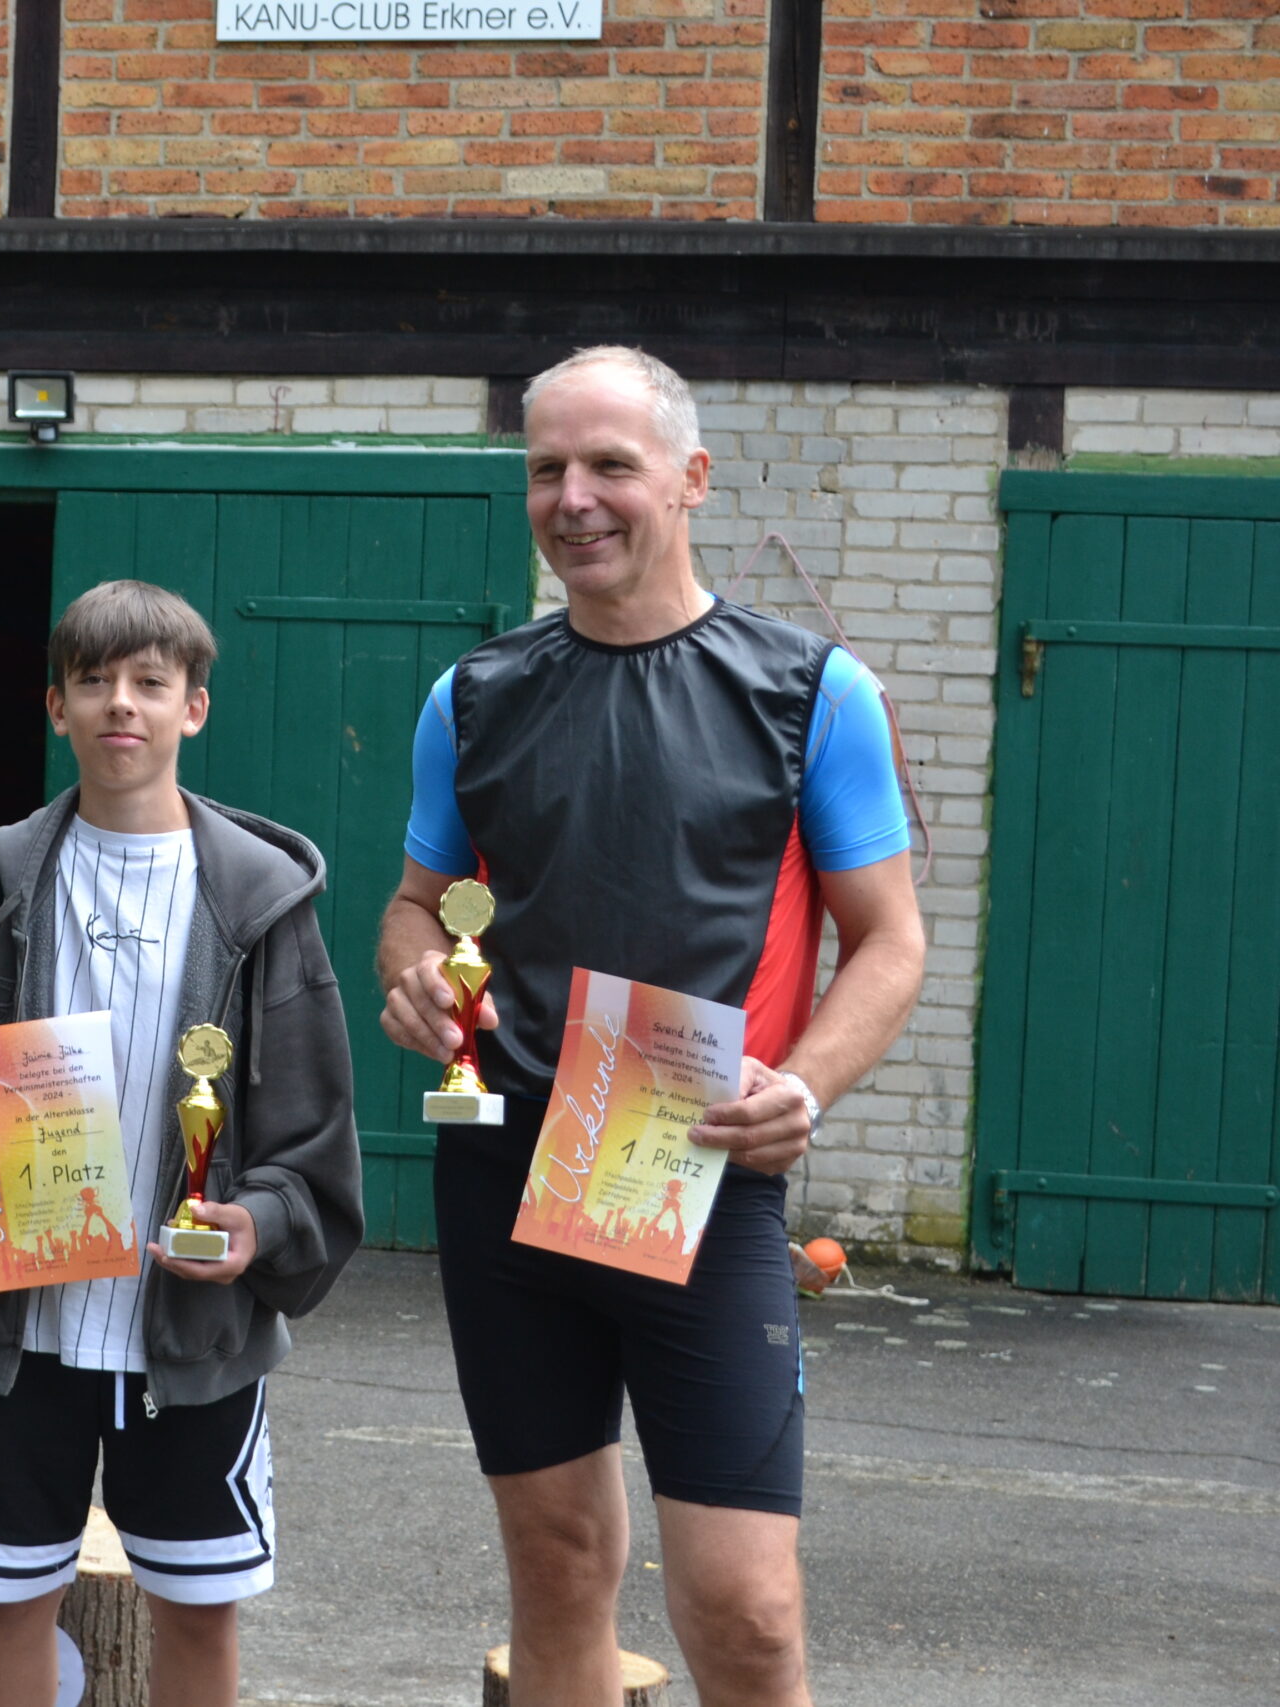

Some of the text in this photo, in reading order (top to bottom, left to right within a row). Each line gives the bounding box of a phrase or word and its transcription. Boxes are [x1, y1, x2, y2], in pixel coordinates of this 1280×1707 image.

[234, 1, 582, 31] KANU-CLUB Erkner e.V.
[653, 1041, 716, 1065] belegte bei den
[19, 1064, 84, 1080] belegte bei den
[672, 1072, 693, 1083] 2024
[4, 1074, 101, 1095] Vereinsmeisterschaften
[651, 1088, 665, 1097] der
[42, 1091, 64, 1100] 2024
[15, 1106, 94, 1123] in der Altersklasse
[540, 1014, 620, 1202] Urkunde
[38, 1122, 81, 1144] Jugend
[662, 1131, 677, 1141] den
[51, 1148, 67, 1157] den
[652, 1148, 704, 1178] Platz
[53, 1163, 105, 1184] Platz
